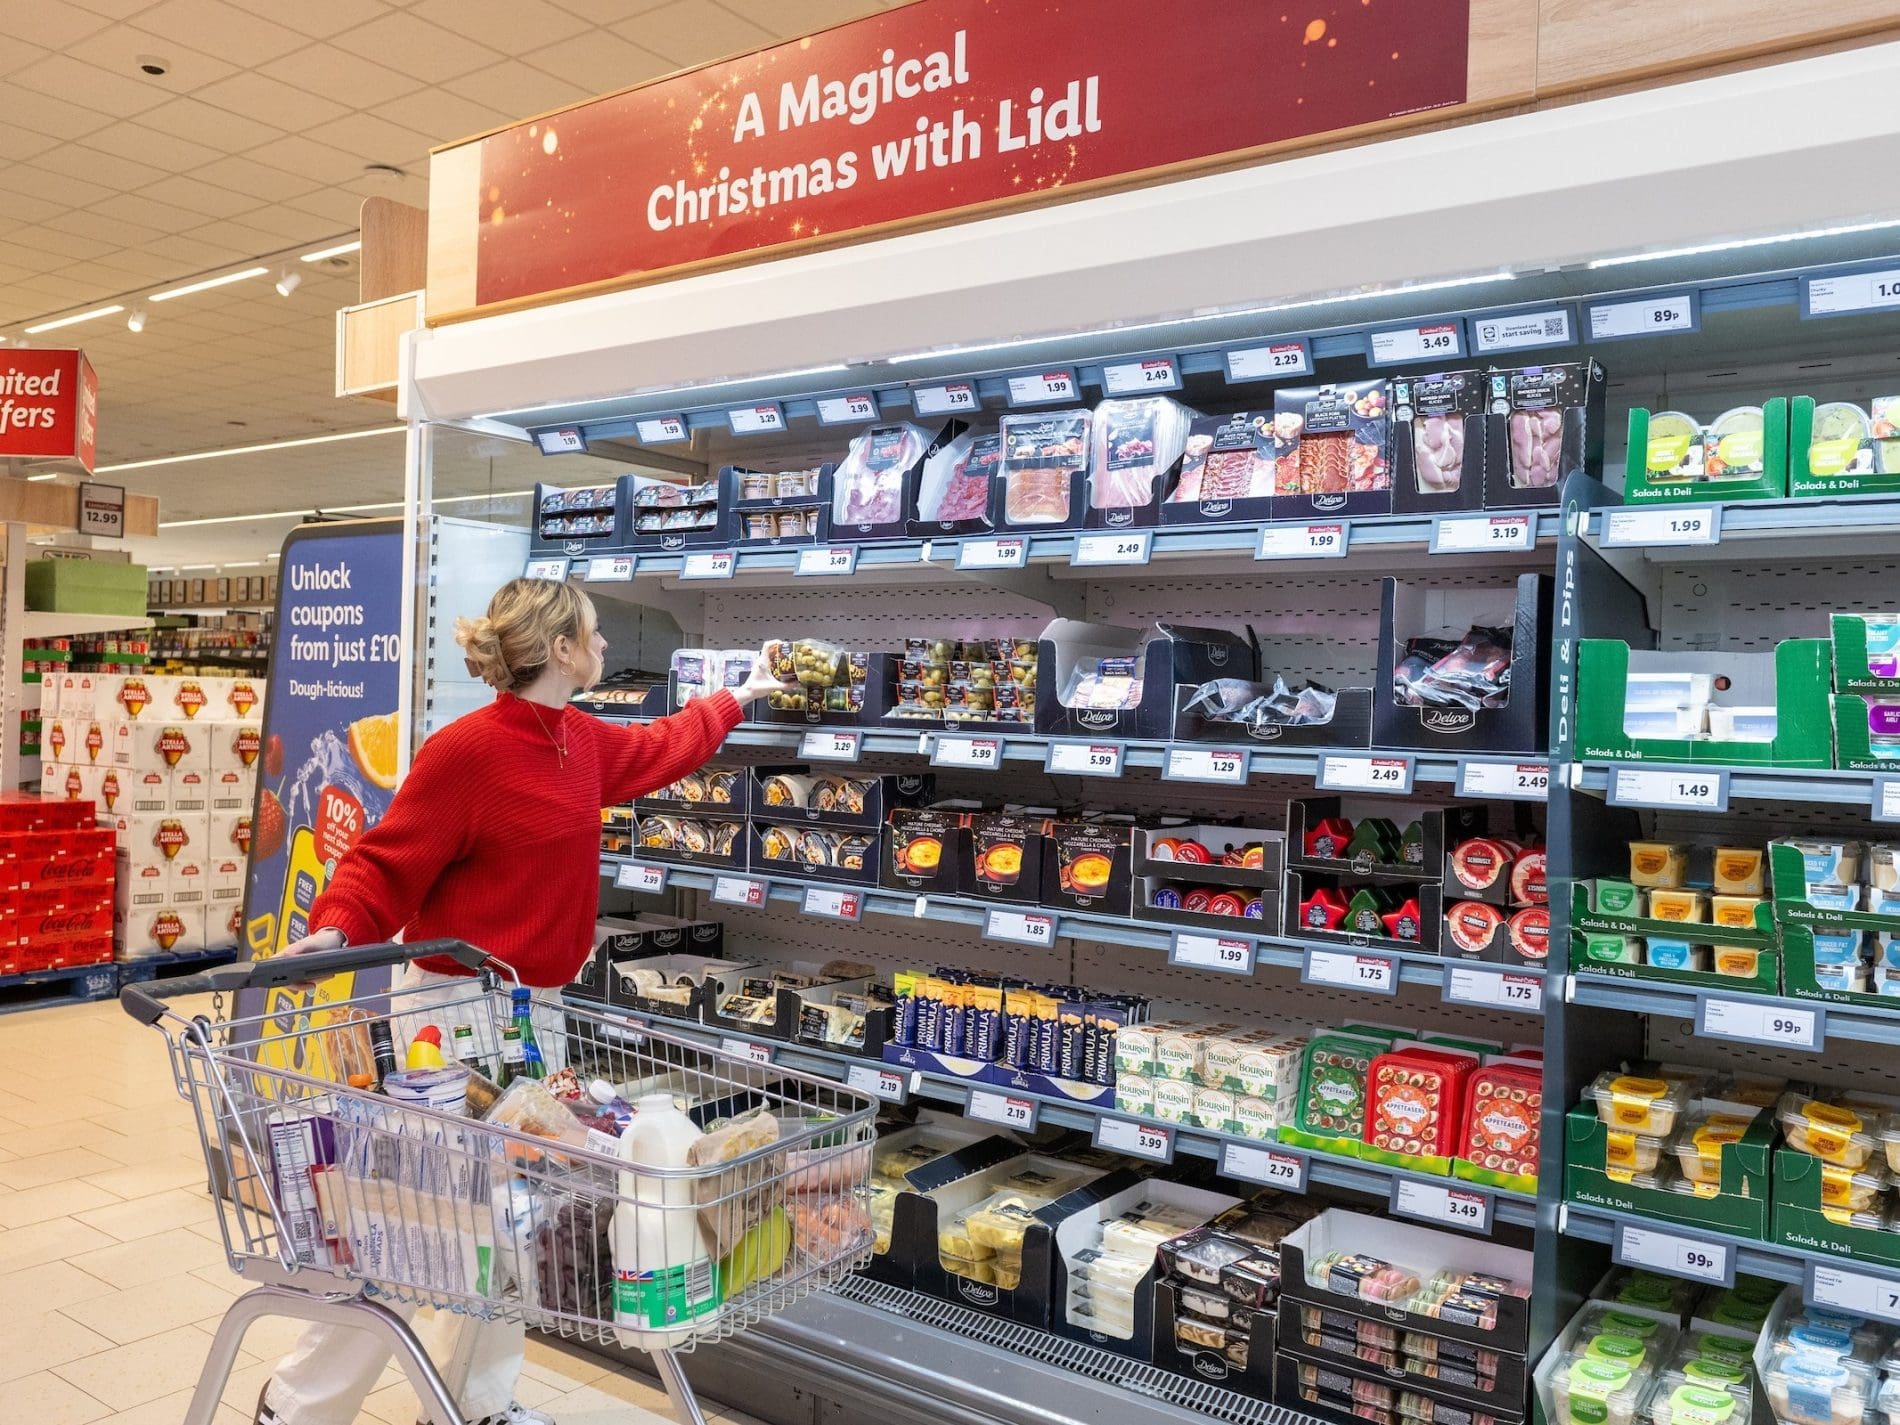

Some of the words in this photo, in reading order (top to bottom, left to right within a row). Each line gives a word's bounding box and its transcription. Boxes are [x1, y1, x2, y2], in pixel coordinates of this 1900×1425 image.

[733, 92, 766, 144] A
[778, 30, 969, 126] Magical
[646, 150, 858, 232] Christmas
[871, 110, 981, 181] with
[998, 75, 1102, 154] Lidl
[1654, 310, 1679, 322] 89p
[1521, 329, 1542, 338] saving
[1423, 336, 1450, 349] 3.49
[1274, 354, 1298, 366] 2.29
[1145, 370, 1167, 381] 2.49
[1047, 381, 1067, 392] 1.99
[950, 393, 968, 403] 2.99
[850, 403, 869, 414] 2.99
[760, 414, 775, 424] 3.29
[664, 425, 679, 435] 1.99
[563, 437, 577, 446] 1.99
[1794, 480, 1828, 491] Salads
[1828, 481, 1837, 489] &
[1839, 479, 1860, 488] Deli
[1632, 487, 1663, 497] Salads
[1664, 488, 1672, 496] &
[1673, 487, 1692, 496] Deli
[1317, 495, 1343, 507] Deluxe
[1204, 501, 1228, 515] Deluxe
[86, 511, 118, 524] 12.99
[1109, 511, 1130, 523] Deluxe
[1671, 520, 1701, 531] 1.99
[1492, 527, 1519, 539] 3.19
[1309, 536, 1333, 546] 1.99
[997, 548, 1016, 558] 1.99
[1117, 544, 1139, 554] 2.49
[711, 561, 727, 570] 2.49
[830, 556, 847, 566] 3.49
[291, 562, 351, 590] Unlock
[613, 565, 628, 574] 6.99
[1561, 549, 1574, 628] Dips
[290, 605, 364, 632] coupons
[290, 634, 329, 661] from
[332, 634, 366, 668] just
[370, 634, 400, 662] £10
[1561, 637, 1570, 664] &
[290, 679, 364, 701] Dough-licious!
[1848, 679, 1877, 688] Salads
[1878, 680, 1886, 688] &
[1558, 673, 1569, 744] Deli
[1081, 710, 1113, 723] Deluxe
[1427, 711, 1469, 725] Deluxe
[834, 743, 851, 751] 3.29
[1585, 747, 1615, 759] Salads
[1616, 750, 1623, 759] &
[1625, 750, 1642, 759] Deli
[971, 749, 991, 759] 5.99
[1090, 756, 1112, 766] 5.99
[1213, 761, 1235, 771] 1.29
[1849, 761, 1877, 770] Salads
[1879, 762, 1886, 770] &
[1373, 769, 1399, 781] 2.49
[1519, 776, 1548, 788] 2.49
[1678, 784, 1709, 797] 1.49
[326, 794, 357, 832] 10%
[298, 878, 313, 892] FREE
[644, 876, 659, 885] 2.99
[1464, 916, 1487, 927] SERIOUSLY
[1788, 909, 1816, 920] Salads
[1826, 912, 1843, 921] Deli
[1026, 925, 1044, 935] 1.85
[1580, 918, 1609, 930] Salads
[1611, 922, 1618, 930] &
[1619, 922, 1637, 932] Deli
[1219, 950, 1242, 962] 1.99
[1359, 967, 1383, 980] 1.75
[1578, 964, 1608, 975] Salads
[1609, 968, 1616, 976] &
[1618, 968, 1636, 978] Deli
[1506, 986, 1532, 1000] 1.75
[1794, 989, 1823, 999] Salads
[1833, 993, 1850, 1002] Deli
[895, 998, 905, 1043] PRIMULA
[926, 1001, 938, 1047] PRIMULA
[1773, 1019, 1801, 1034] 99p
[944, 1008, 954, 1054] PRIMULA
[965, 1009, 975, 1055] PRIMULA
[977, 1012, 990, 1059] PRIMULA
[1006, 1018, 1019, 1064] PRIMULA
[1028, 1018, 1038, 1065] PRIMULA
[1041, 1022, 1052, 1071] PRIMULA
[1062, 1027, 1073, 1077] PRIMULA
[1084, 1028, 1096, 1077] PRIMULA
[1097, 1033, 1110, 1083] PRIMULA
[880, 1080, 897, 1092] 2.19
[1007, 1108, 1026, 1119] 2.19
[1386, 1103, 1425, 1115] APPETEASERS
[1484, 1117, 1526, 1131] APPETEASERS
[1139, 1136, 1162, 1149] 3.99
[1270, 1164, 1294, 1178] 2.79
[1575, 1191, 1605, 1203] Salads
[1615, 1199, 1633, 1210] Deli
[1450, 1202, 1477, 1217] 3.49
[1786, 1232, 1819, 1247] Salads
[1820, 1241, 1828, 1249] &
[1831, 1242, 1851, 1254] Deli
[1687, 1252, 1713, 1268] 99p
[963, 1280, 994, 1300] Deluxe
[1197, 1358, 1225, 1376] Deluxe
